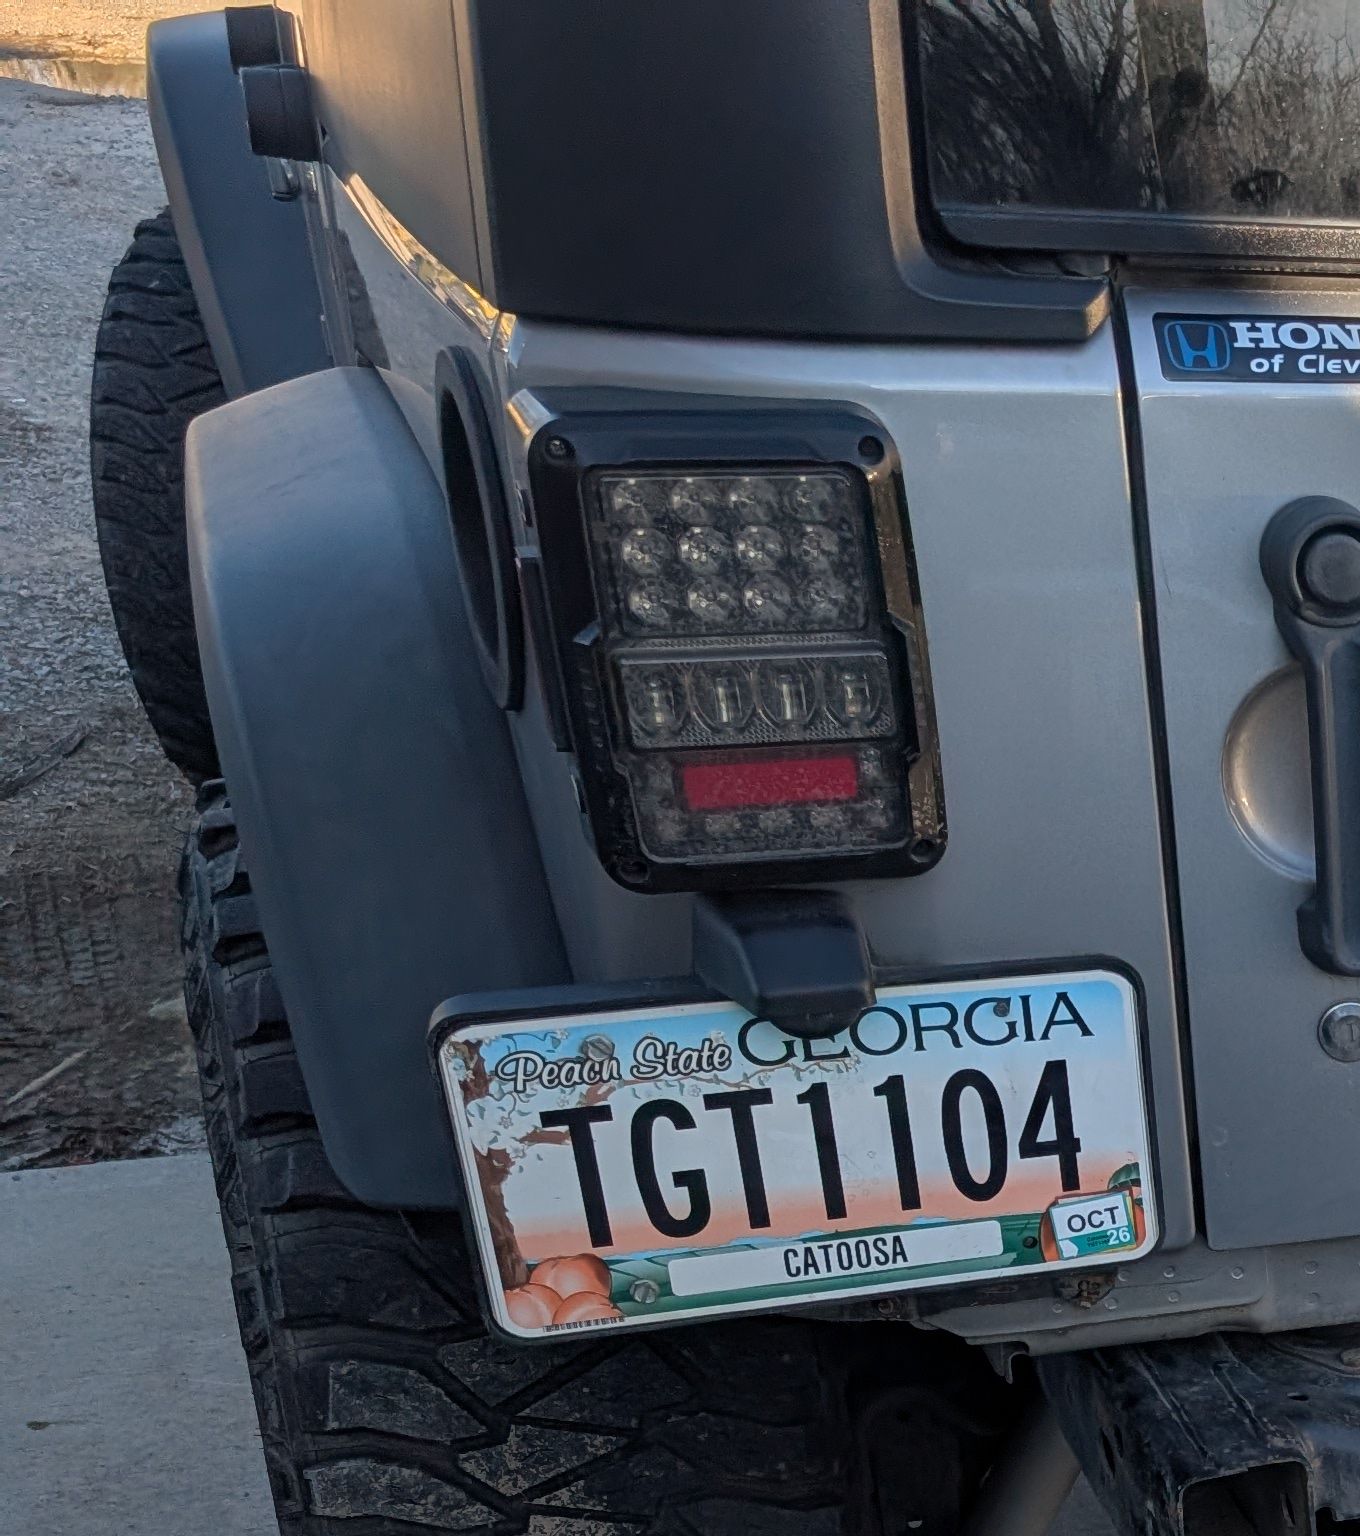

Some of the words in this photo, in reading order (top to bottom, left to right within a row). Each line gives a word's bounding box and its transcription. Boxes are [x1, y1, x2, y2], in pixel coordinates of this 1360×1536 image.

[1250, 354, 1284, 374] of
[630, 1036, 732, 1079] State
[538, 1059, 1082, 1249] TGT1104
[1067, 1205, 1119, 1233] OCT
[1106, 1226, 1131, 1246] 26
[783, 1235, 909, 1278] CATOOSA
